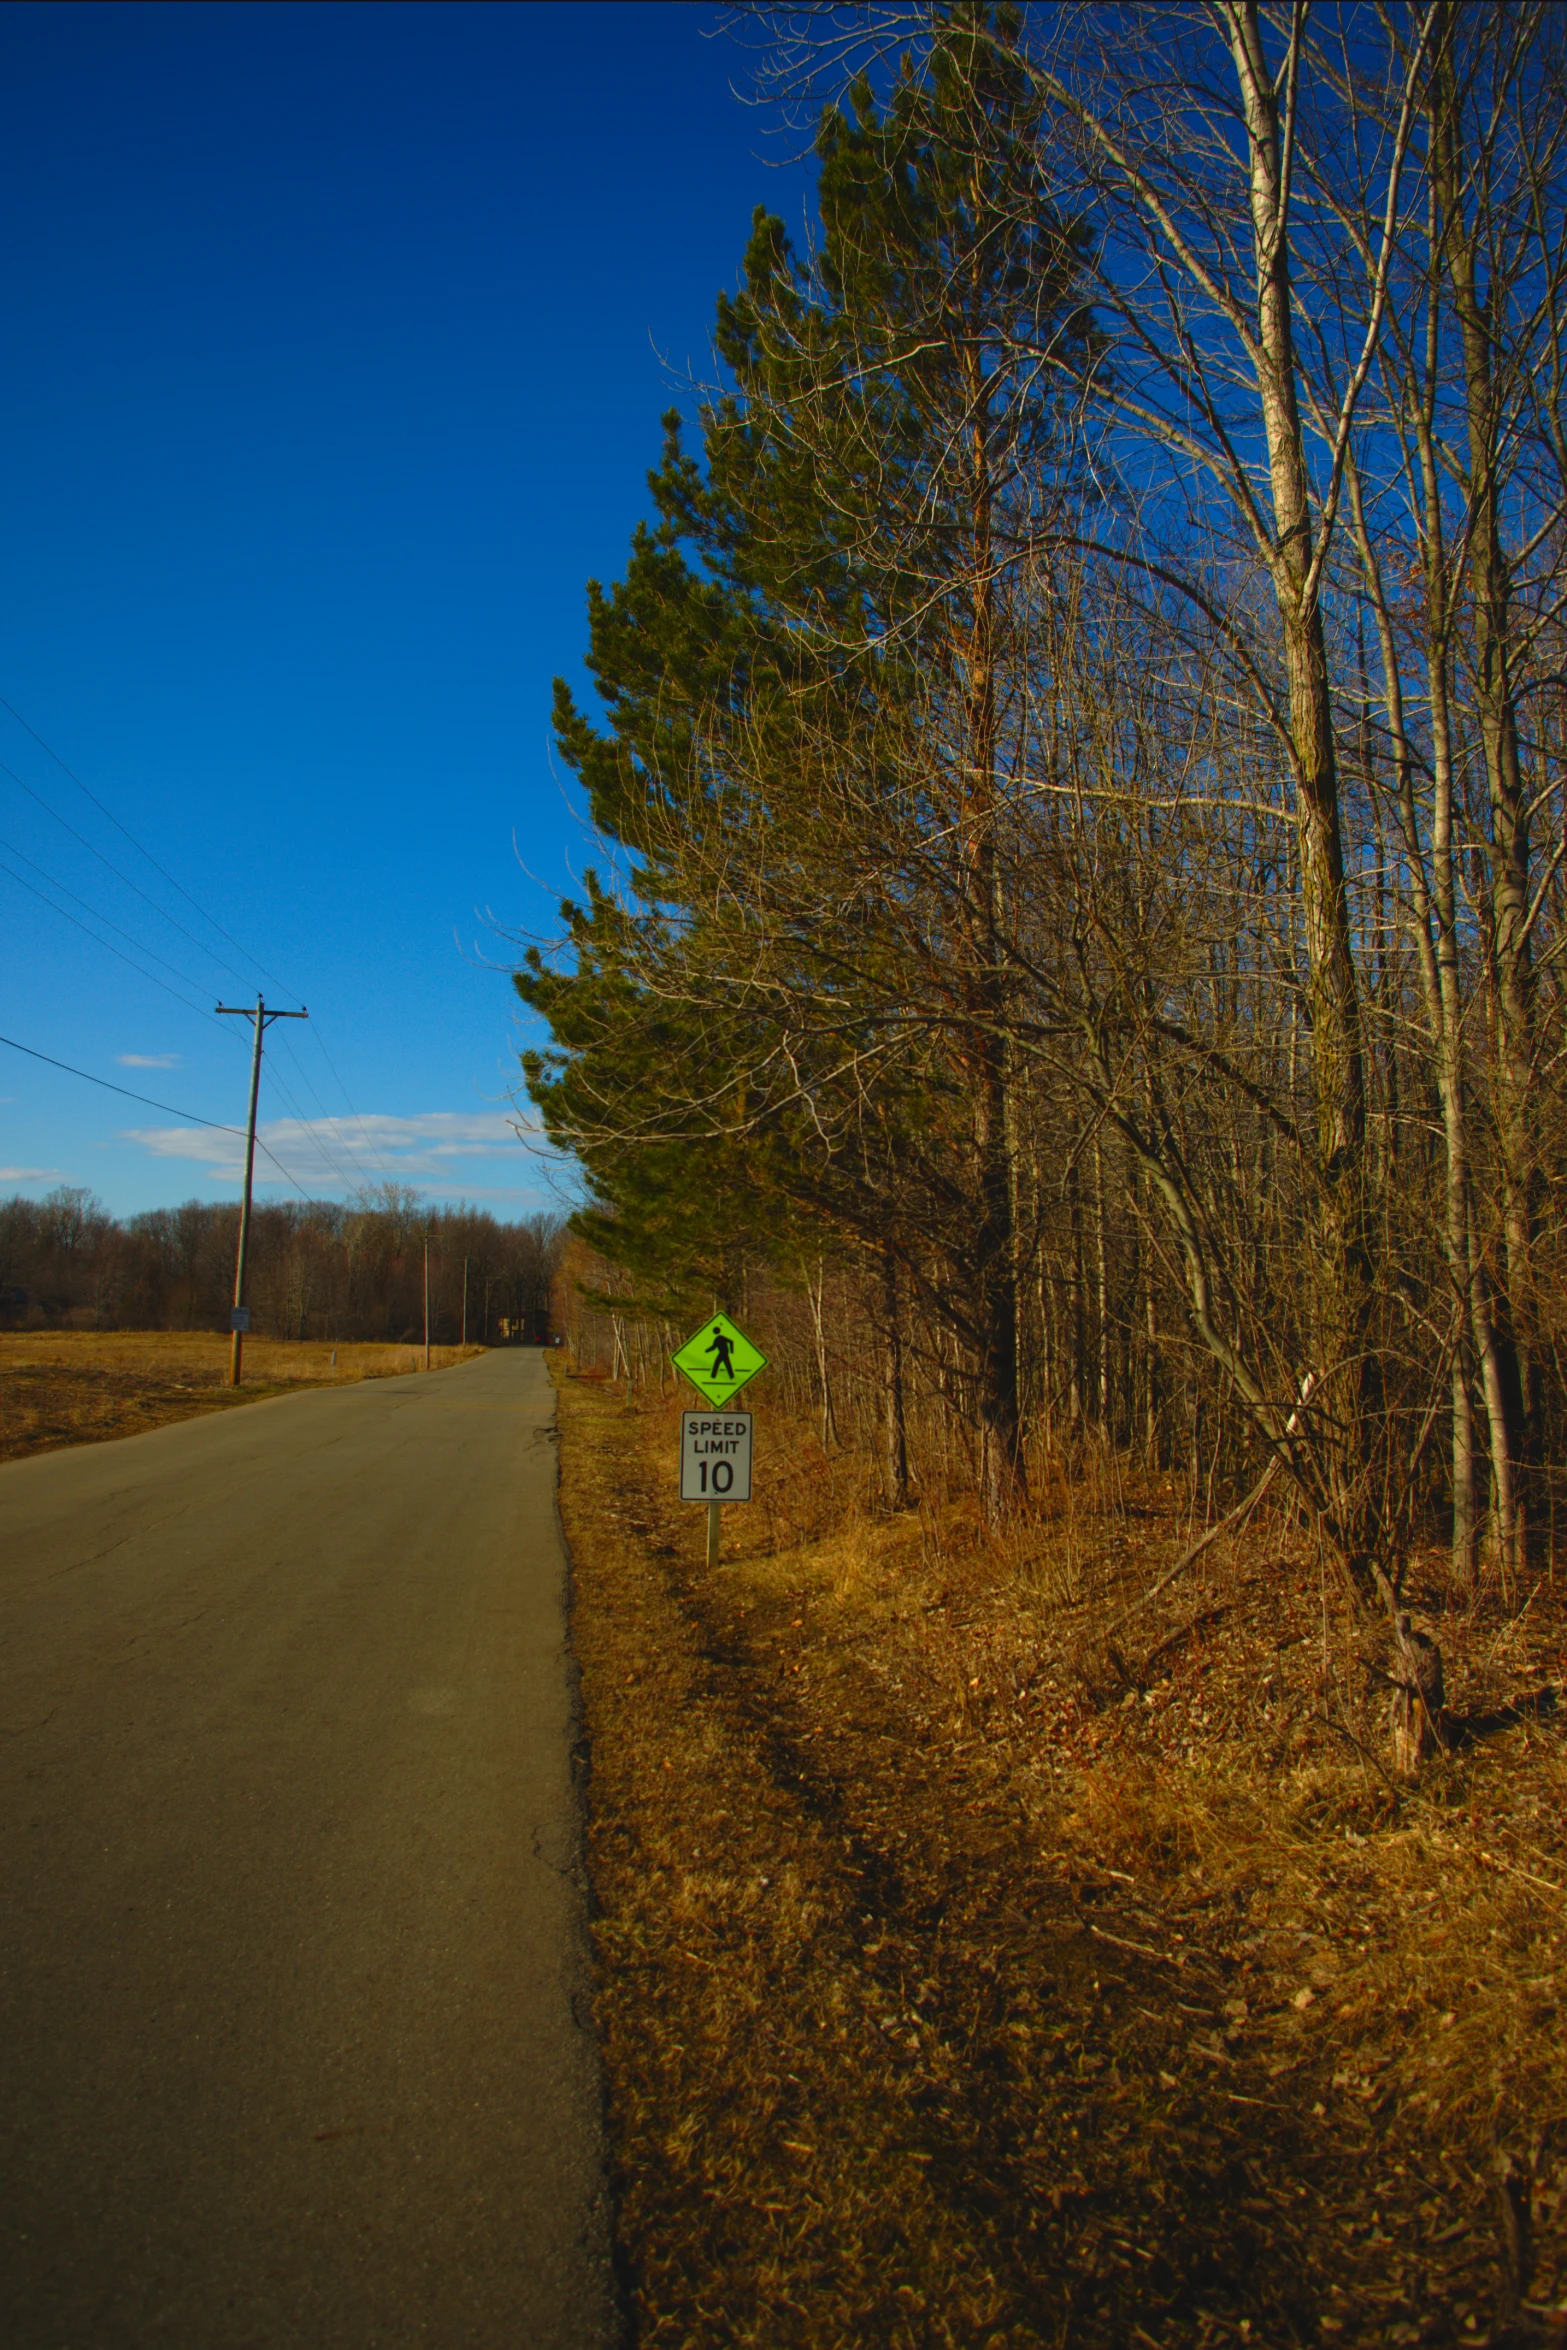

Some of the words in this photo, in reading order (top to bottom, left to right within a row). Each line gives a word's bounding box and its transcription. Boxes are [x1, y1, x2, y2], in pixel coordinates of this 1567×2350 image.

[688, 1421, 747, 1436] SPEED
[694, 1440, 740, 1454] LIMIT
[699, 1460, 734, 1494] 10
